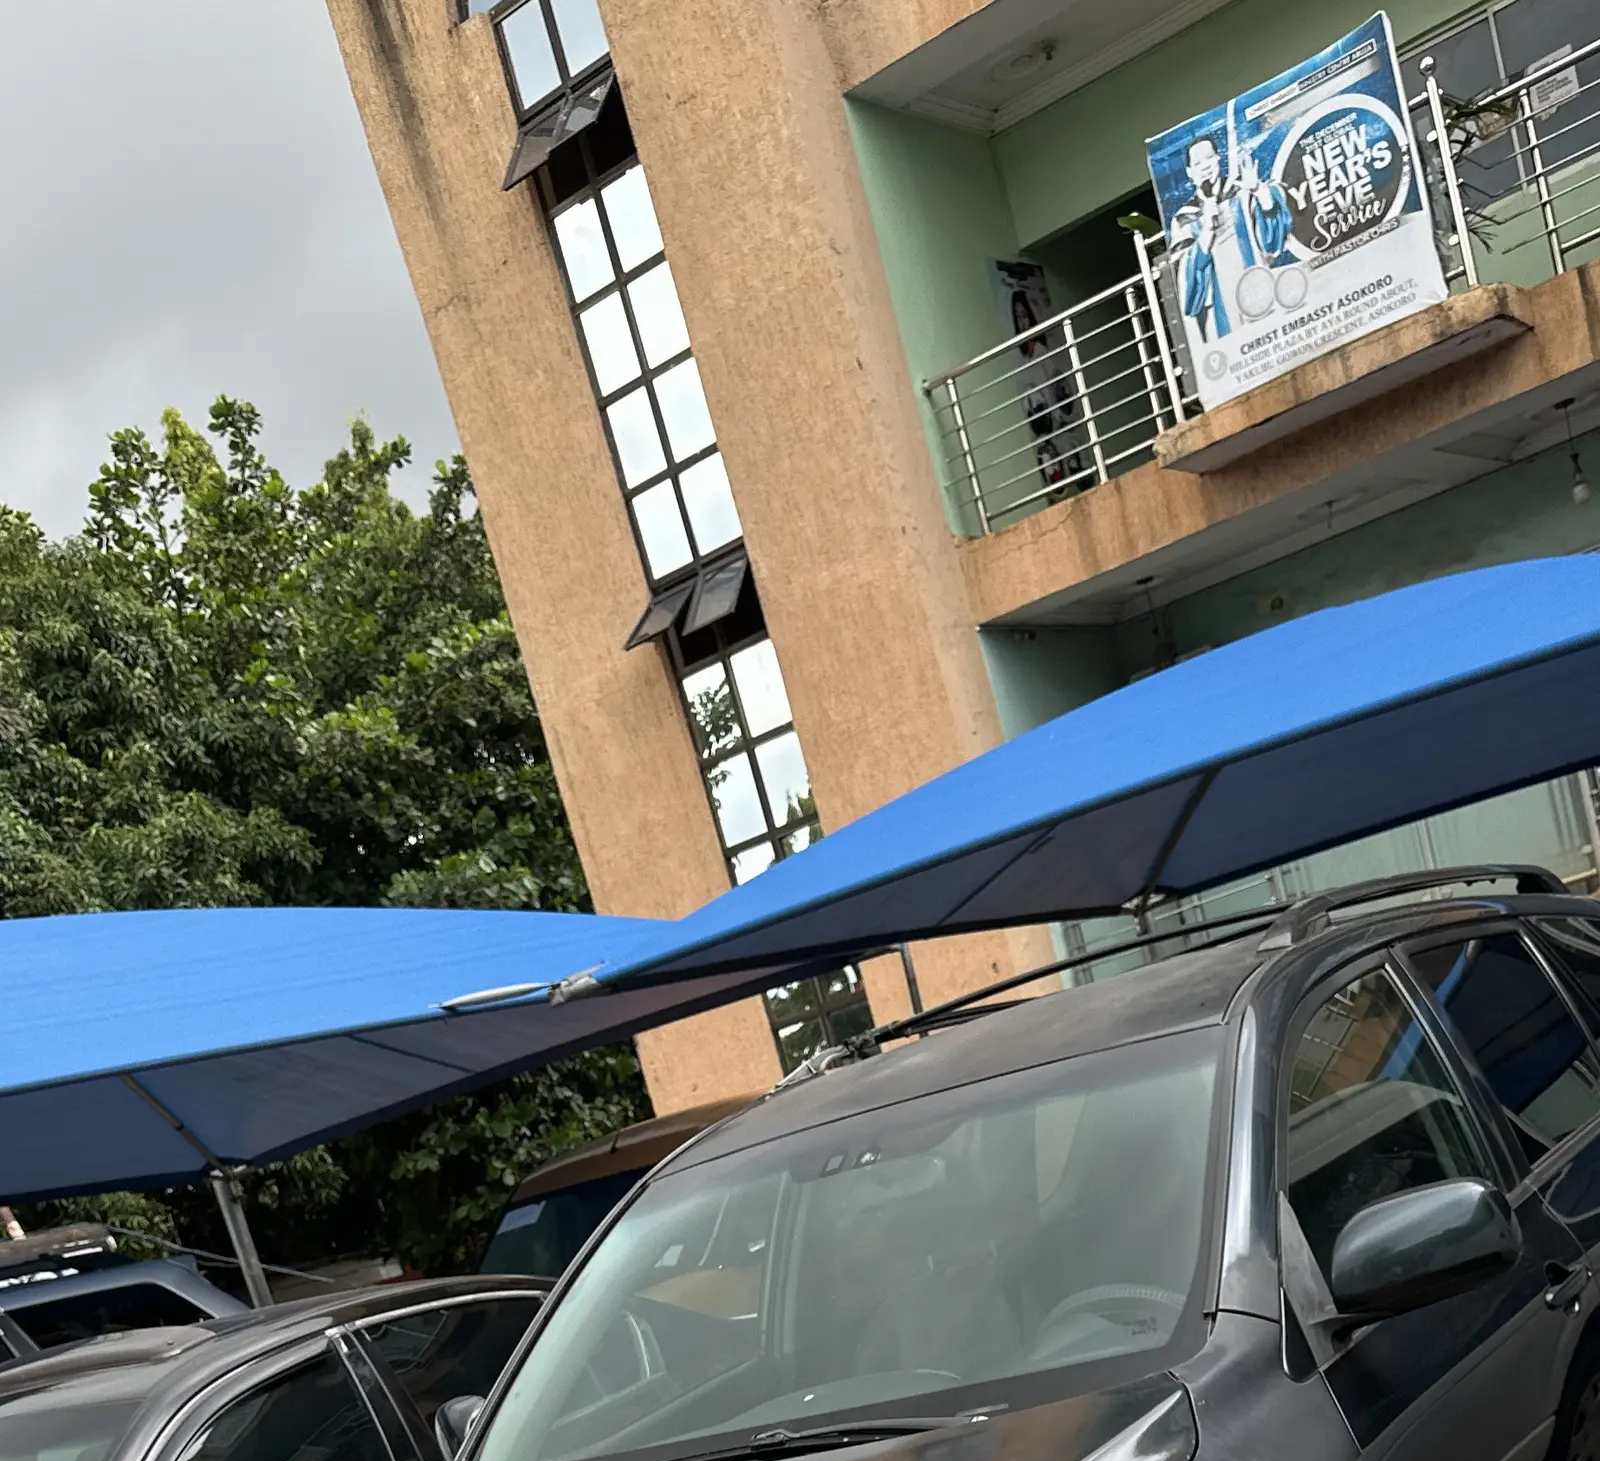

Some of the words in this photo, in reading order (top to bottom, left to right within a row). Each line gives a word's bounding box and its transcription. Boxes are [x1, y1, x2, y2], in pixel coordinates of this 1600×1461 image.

[1288, 141, 1392, 210] YEAR'S
[1302, 124, 1367, 180] NEW
[1310, 199, 1386, 252] Service
[1316, 175, 1376, 224] EVE
[1240, 329, 1278, 355] CHRIST
[1281, 302, 1334, 336] EMBASSY
[1337, 275, 1393, 310] ASOKORO
